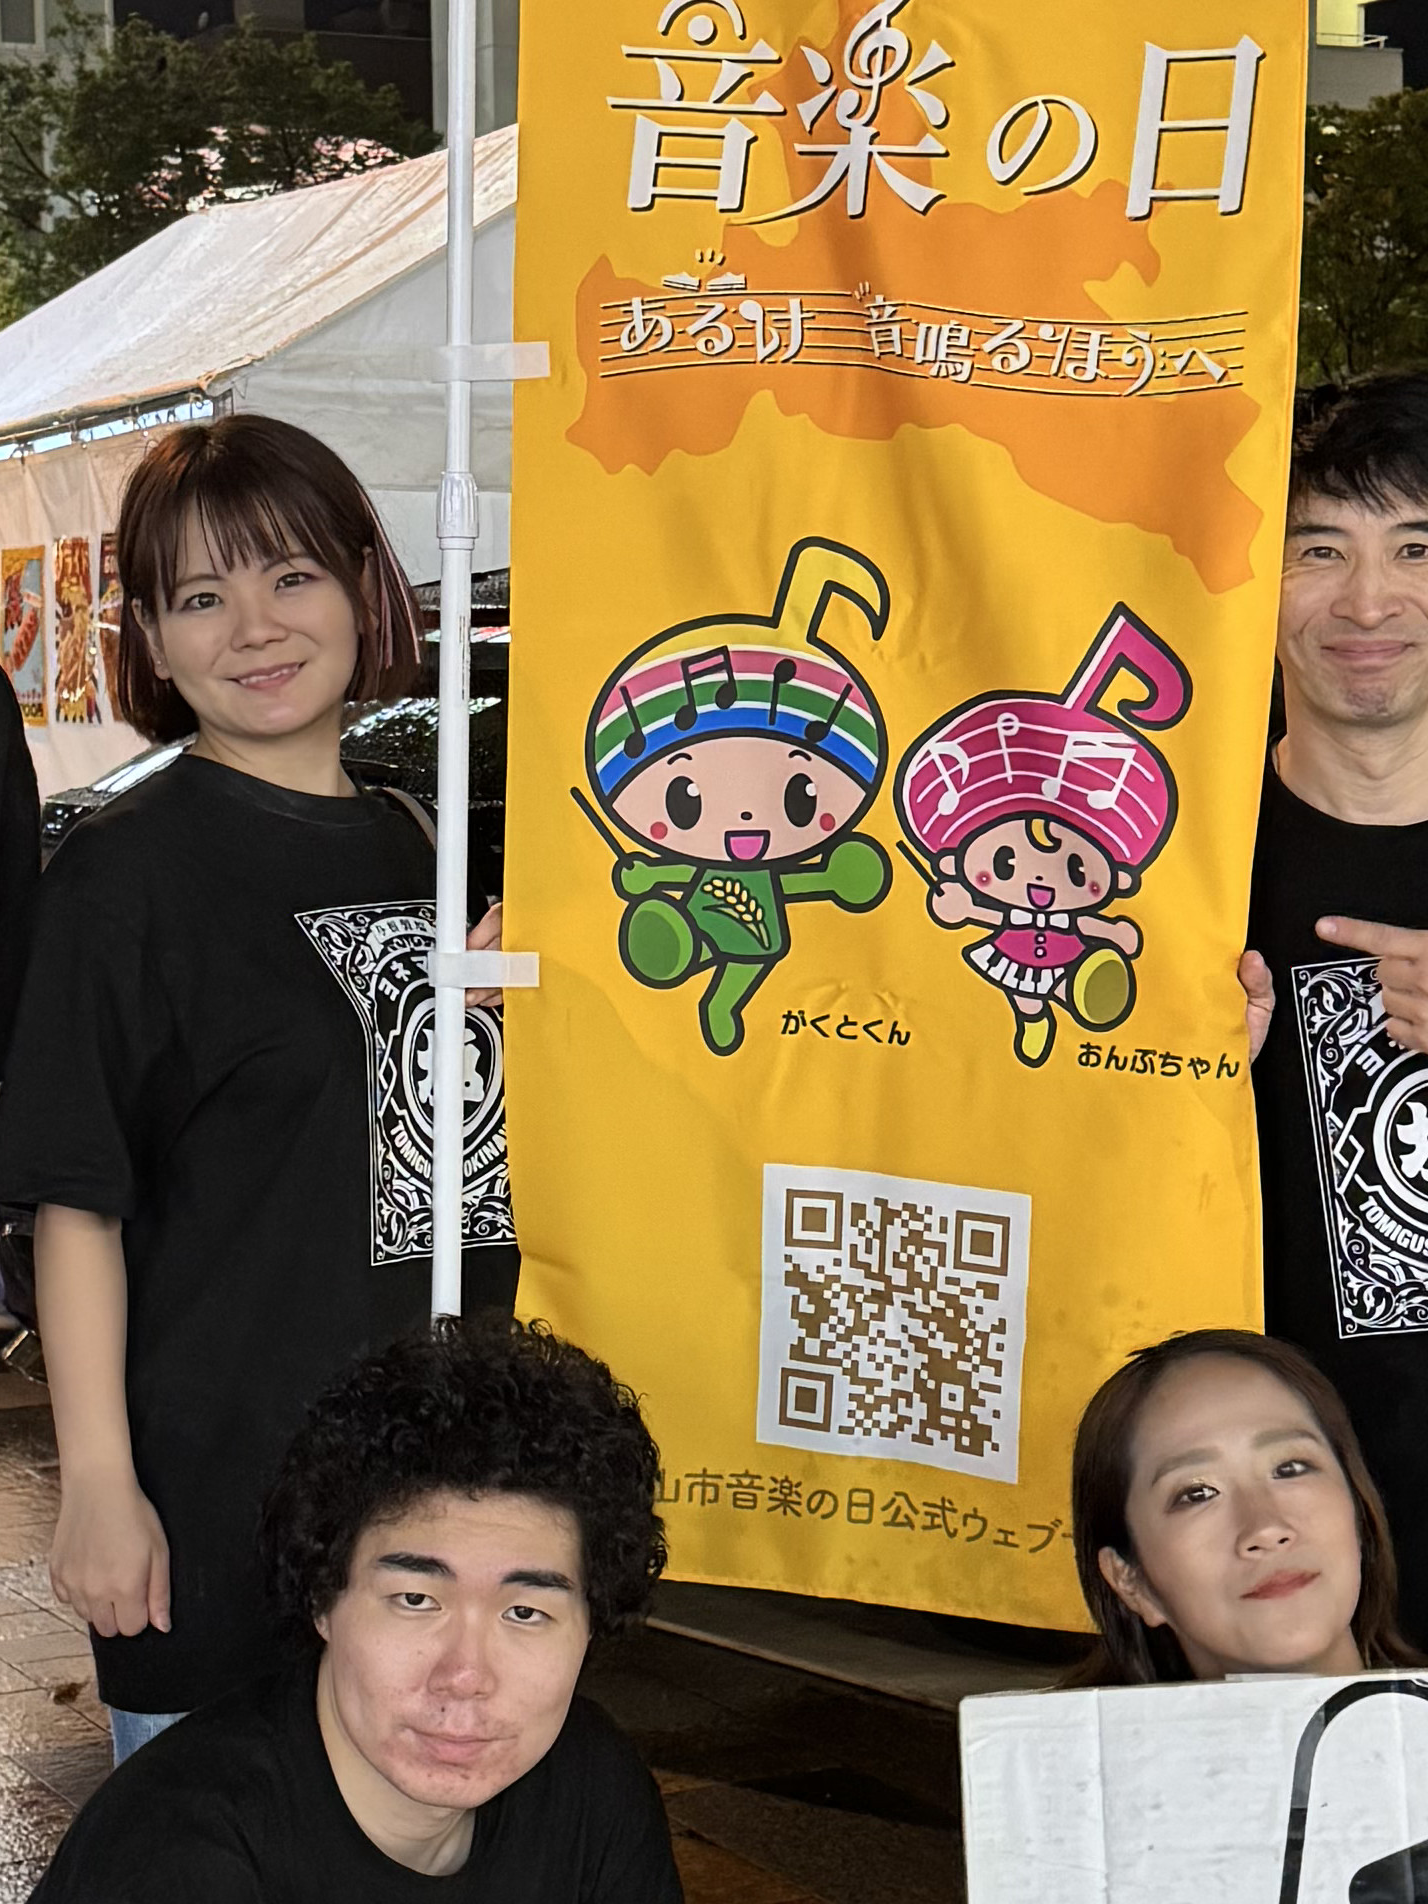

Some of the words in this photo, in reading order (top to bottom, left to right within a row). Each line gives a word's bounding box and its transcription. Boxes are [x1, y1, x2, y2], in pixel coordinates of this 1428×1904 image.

[619, 297, 815, 363] あるけ
[864, 294, 1229, 397] 音鳴るほうへ
[780, 1010, 912, 1048] がくとくん
[1076, 1042, 1241, 1079] おんぷちゃん
[390, 1119, 431, 1179] TOMIGU
[655, 1468, 1073, 1553] 山市音楽の日公式ウェブ
